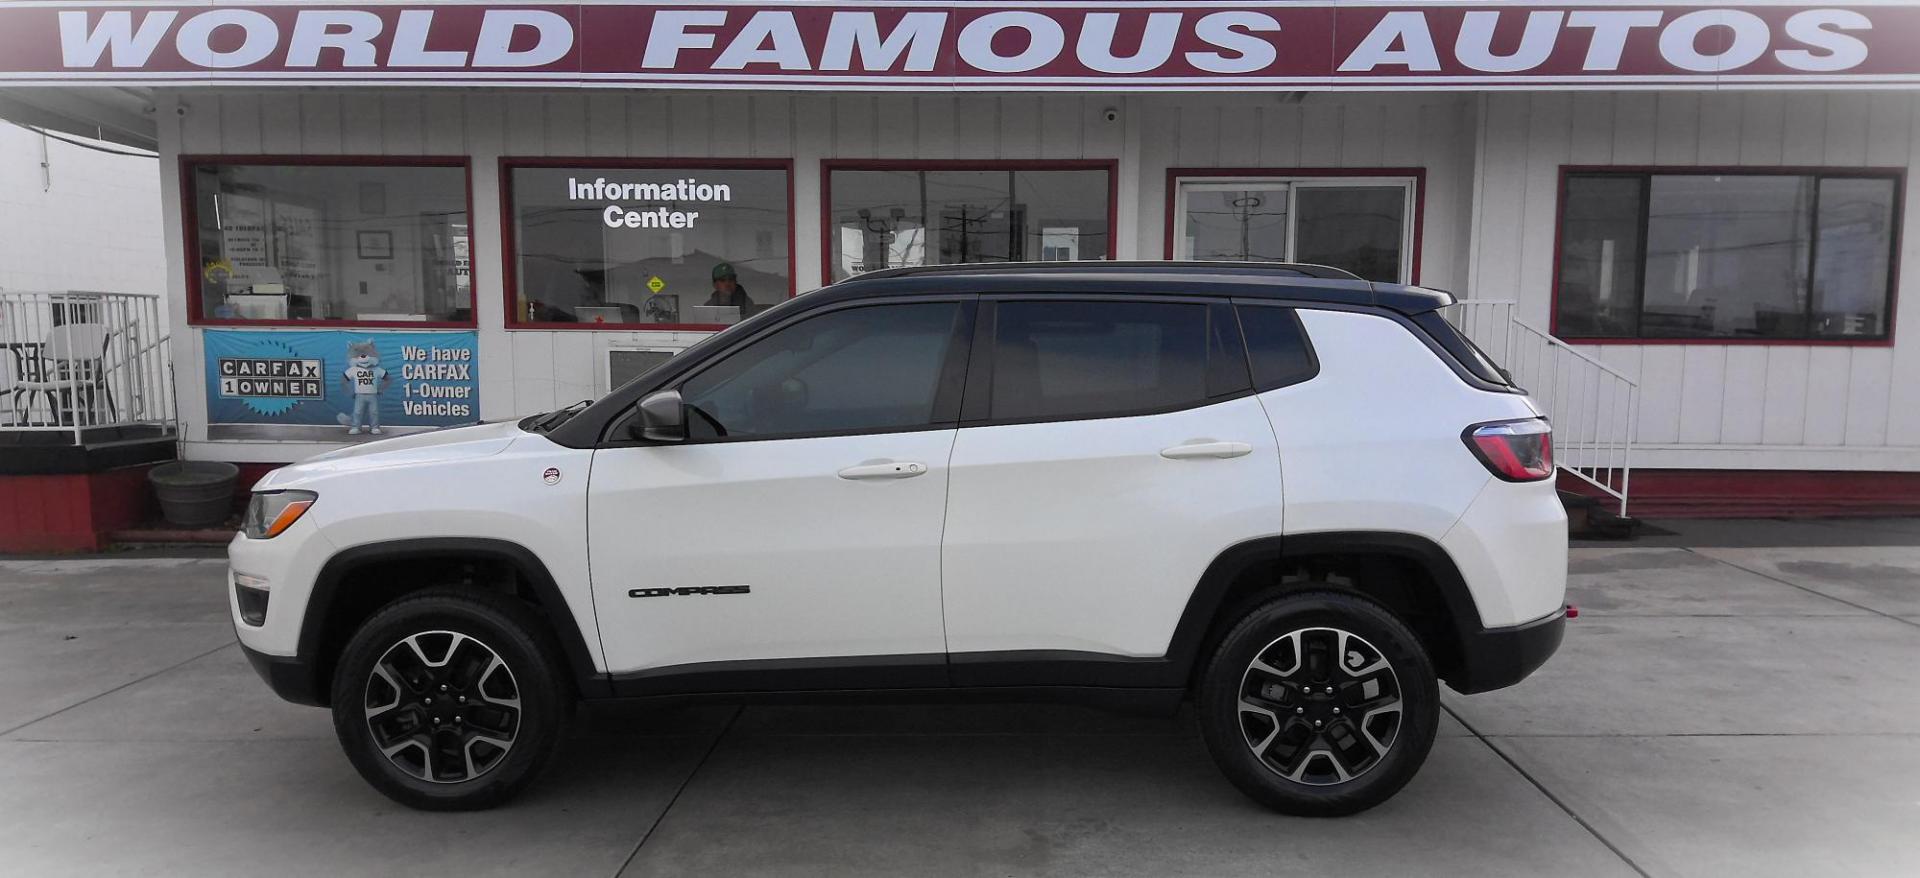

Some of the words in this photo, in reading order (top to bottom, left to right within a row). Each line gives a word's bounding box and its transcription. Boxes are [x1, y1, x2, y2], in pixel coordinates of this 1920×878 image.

[58, 8, 574, 68] WORLD
[640, 10, 1281, 74] FAMOUS
[1336, 8, 1874, 73] AUTOS
[568, 177, 731, 202] Information
[603, 204, 699, 229] Center
[401, 345, 426, 361] We
[431, 345, 471, 361] have
[222, 361, 318, 378] CARFAX
[356, 370, 375, 378] CAR
[402, 363, 470, 380] CARFAX
[357, 378, 374, 386] FOX
[402, 382, 471, 398] 1-Owner
[402, 400, 470, 416] Vehicles
[628, 585, 751, 598] COMPASS
